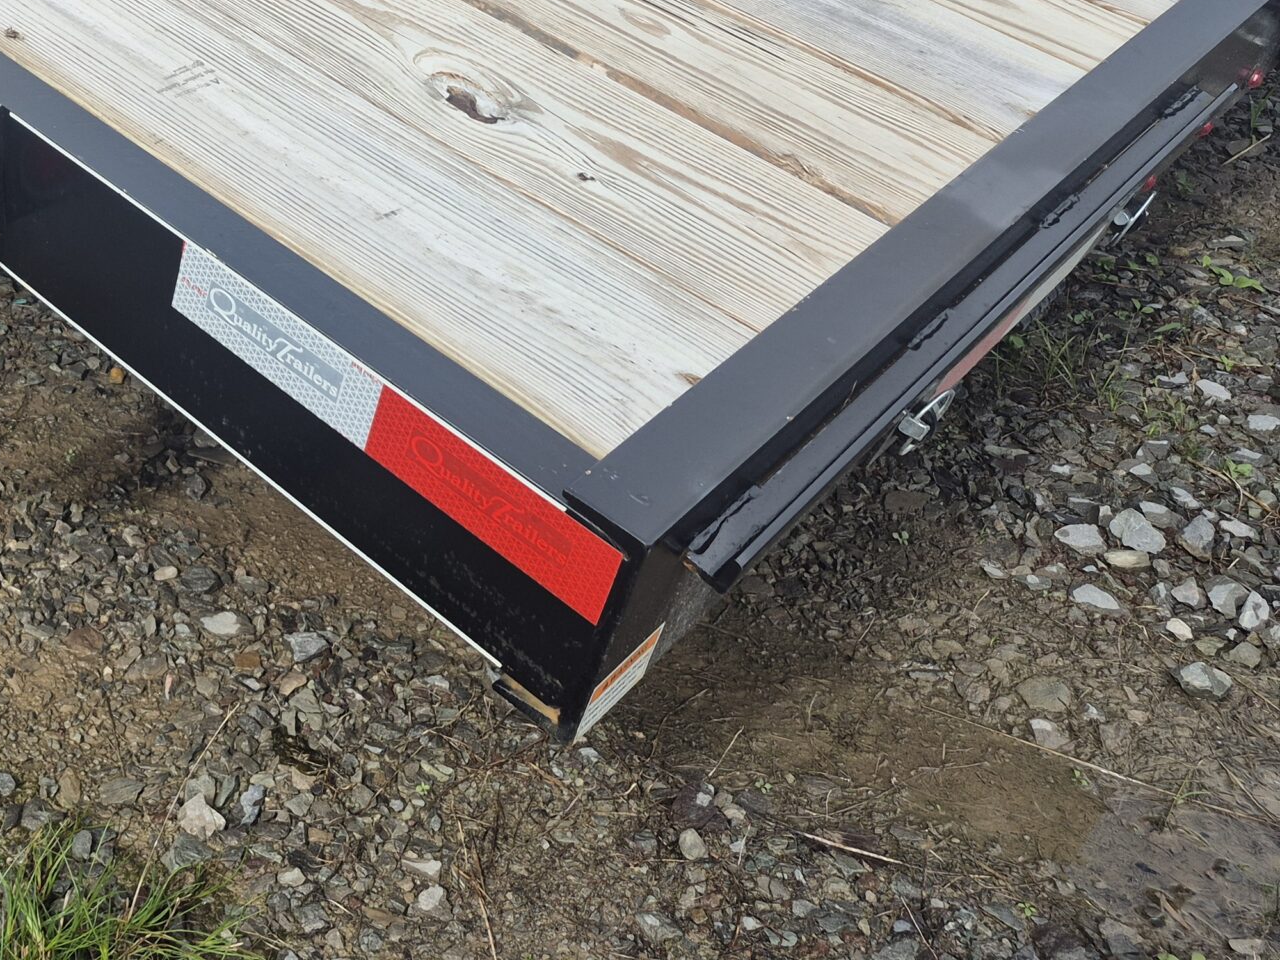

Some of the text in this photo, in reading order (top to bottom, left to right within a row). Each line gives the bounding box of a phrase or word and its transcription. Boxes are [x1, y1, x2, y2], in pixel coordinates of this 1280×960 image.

[209, 288, 338, 398] Quality Trailers
[410, 435, 567, 564] Quality Trailers
